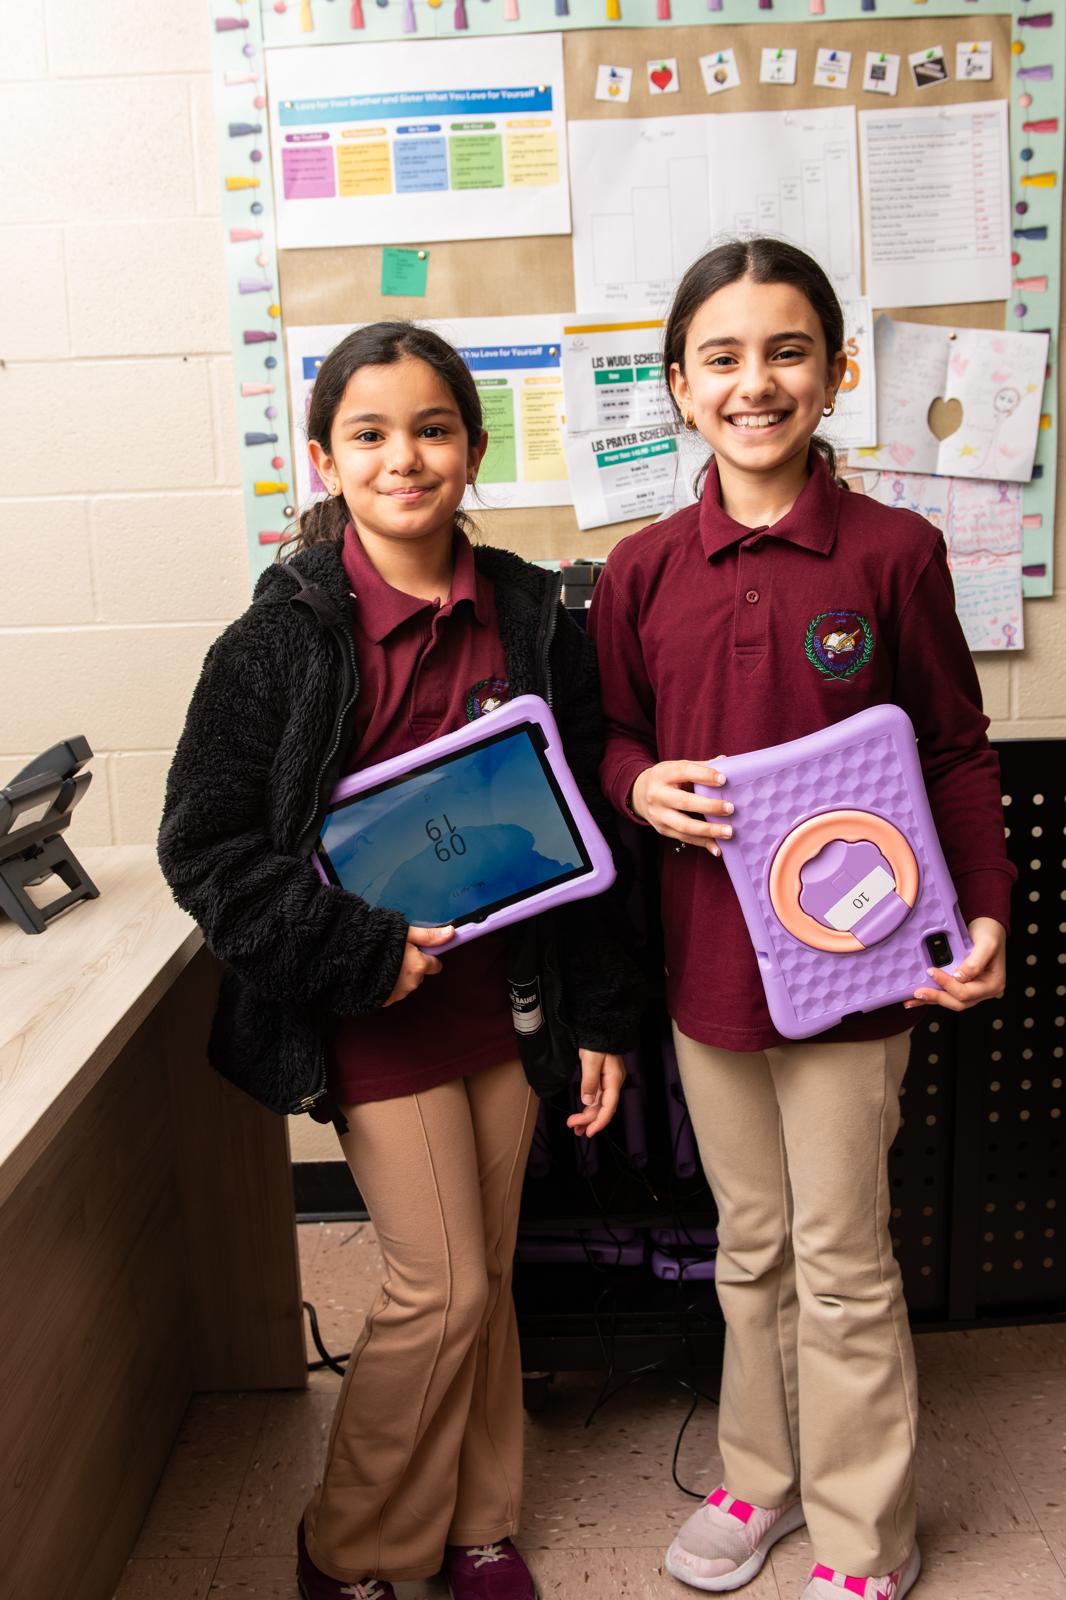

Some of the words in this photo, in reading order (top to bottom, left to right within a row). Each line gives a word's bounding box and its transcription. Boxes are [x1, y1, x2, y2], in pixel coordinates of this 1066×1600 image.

[294, 100, 316, 111] Love
[350, 97, 381, 107] Brother
[382, 96, 399, 105] and
[399, 94, 423, 104] Sister
[424, 93, 447, 102] What
[448, 92, 465, 101] You
[466, 91, 486, 101] Love
[487, 90, 500, 100] for
[501, 89, 536, 99] Yourself
[464, 350, 479, 359] You
[480, 349, 498, 358] Love
[499, 348, 510, 357] for
[511, 346, 543, 357] Yourself
[592, 356, 604, 369] LIS
[606, 354, 631, 368] WUDU
[633, 352, 664, 365] SCHED
[591, 440, 605, 453] LIS
[606, 432, 638, 450] PRAYER
[852, 891, 870, 909] 10
